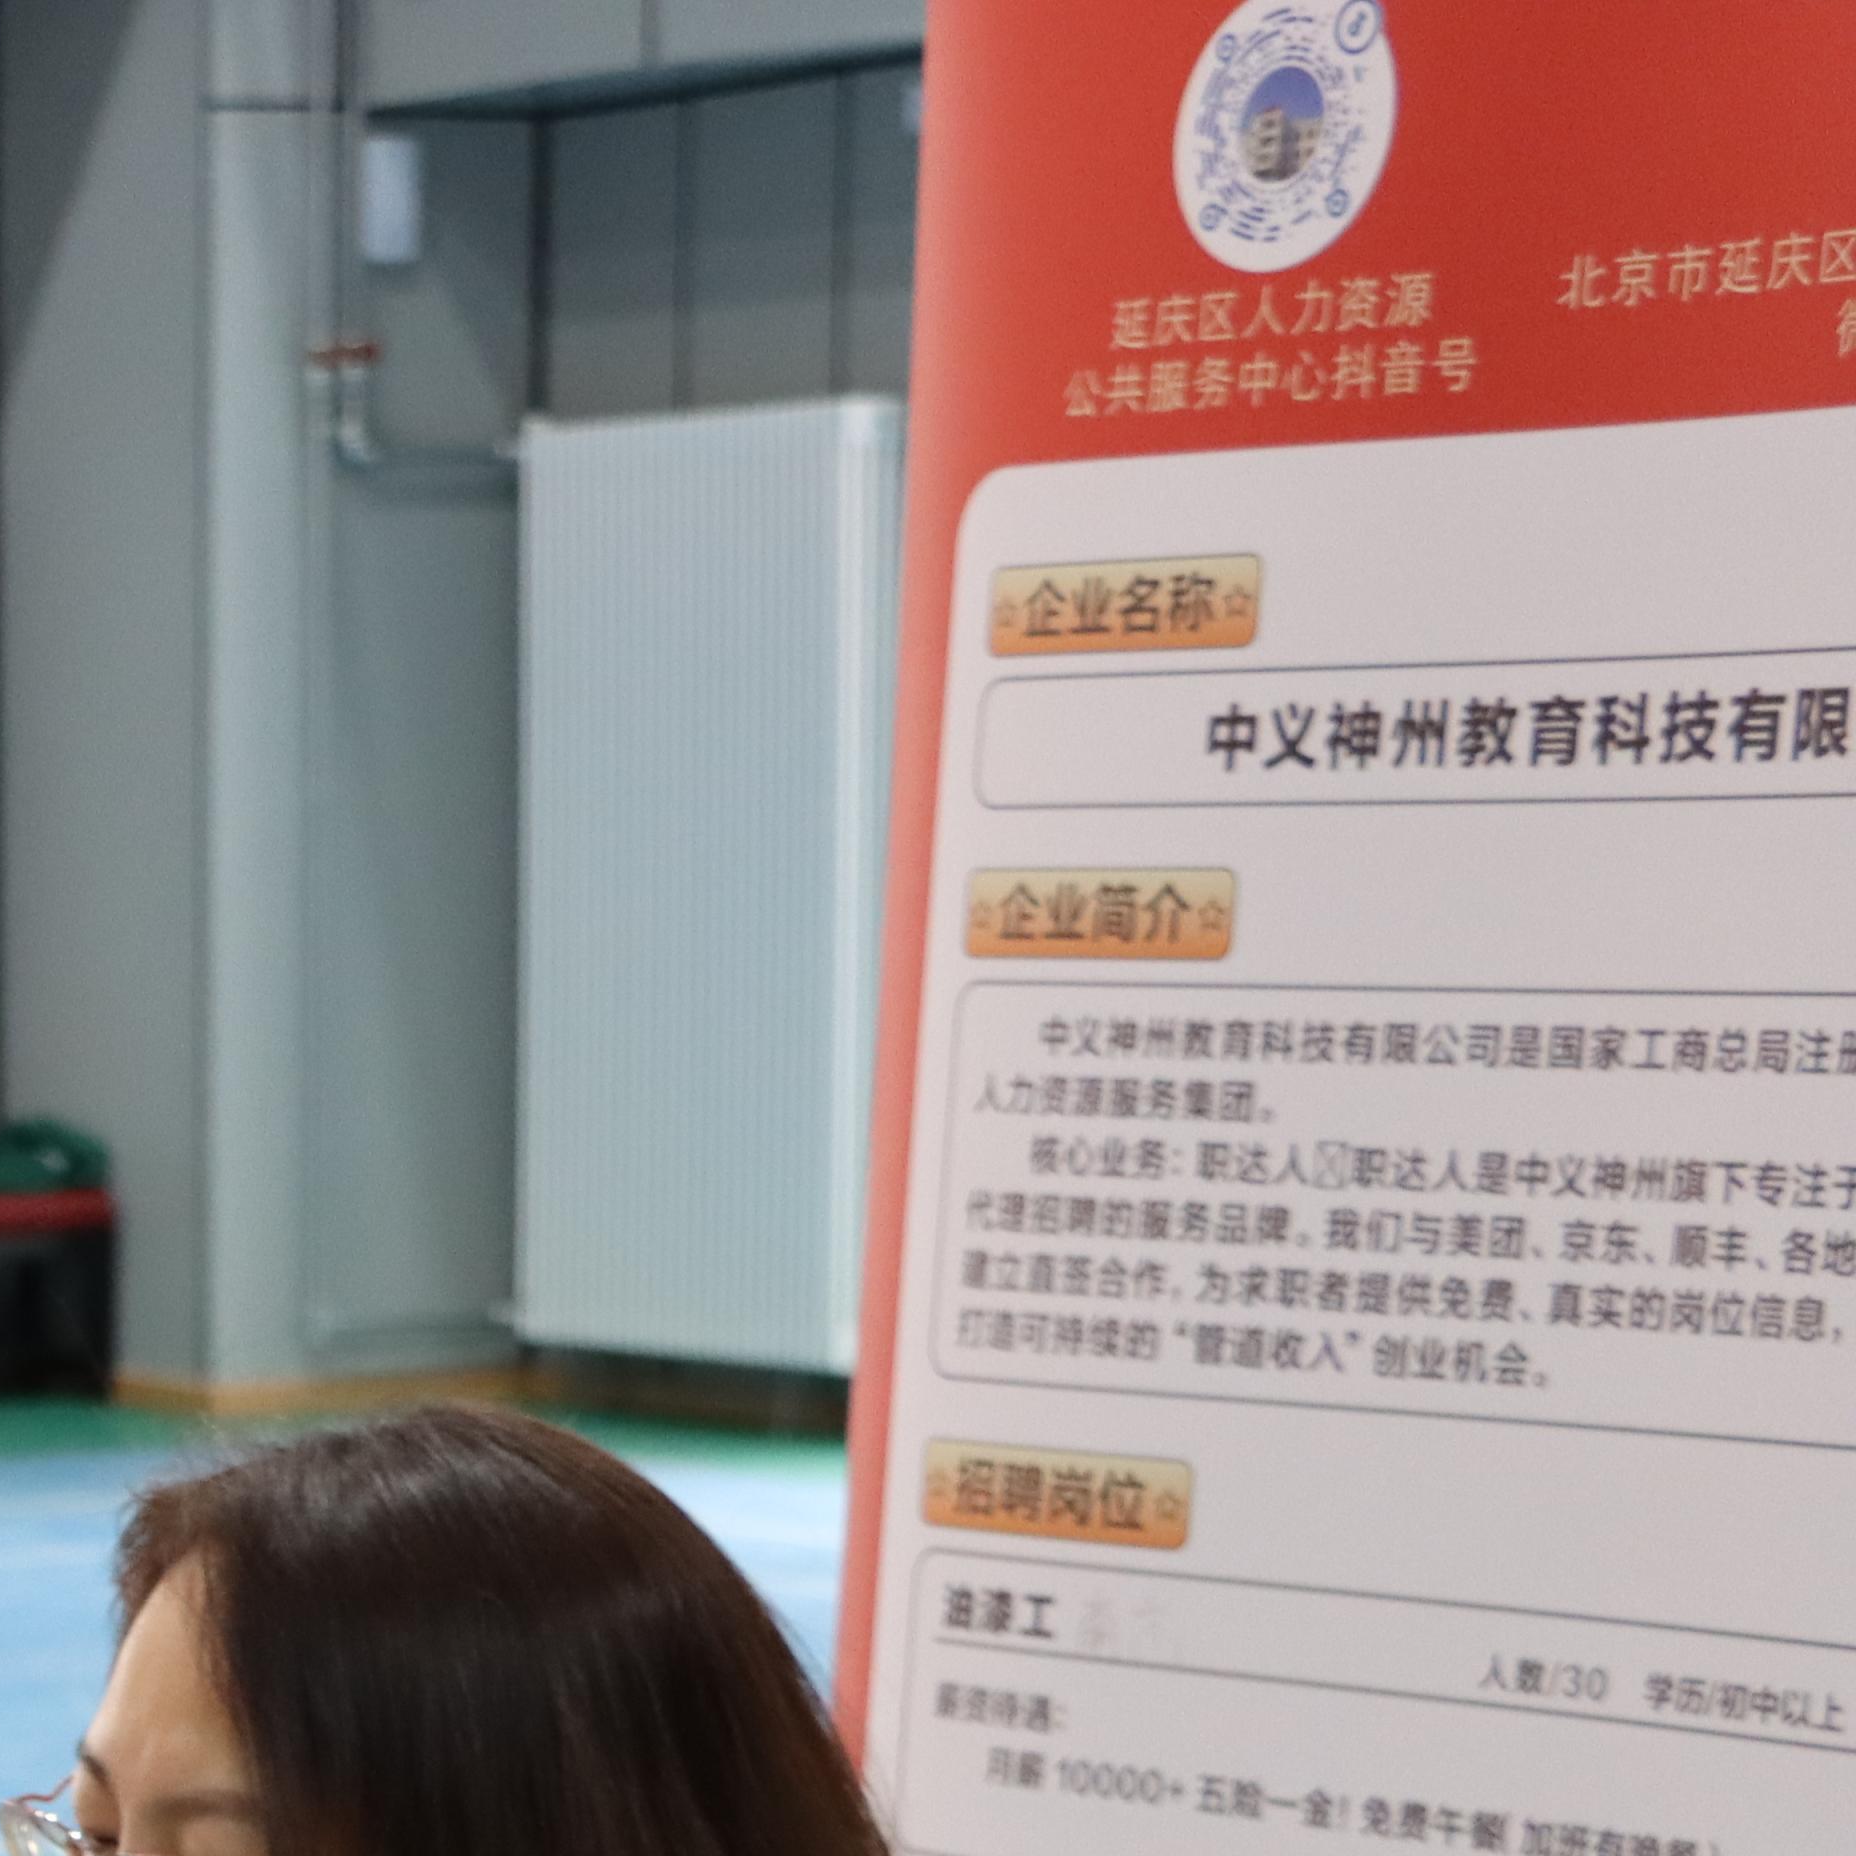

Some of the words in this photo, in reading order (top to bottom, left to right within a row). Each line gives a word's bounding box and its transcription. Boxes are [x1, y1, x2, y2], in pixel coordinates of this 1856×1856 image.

[1557, 229, 1856, 309] 北京市延庆区
[1111, 273, 1434, 349] 延庆区人力资源
[1064, 336, 1476, 416] 公共服务中心抖音号
[1025, 573, 1215, 636] 企业名称
[1206, 688, 1851, 771] 中义神州教育科技有限
[1000, 883, 1189, 942] 企业简介
[956, 1459, 1144, 1530] 招聘岗位
[1478, 1652, 1610, 1702] 人数/30
